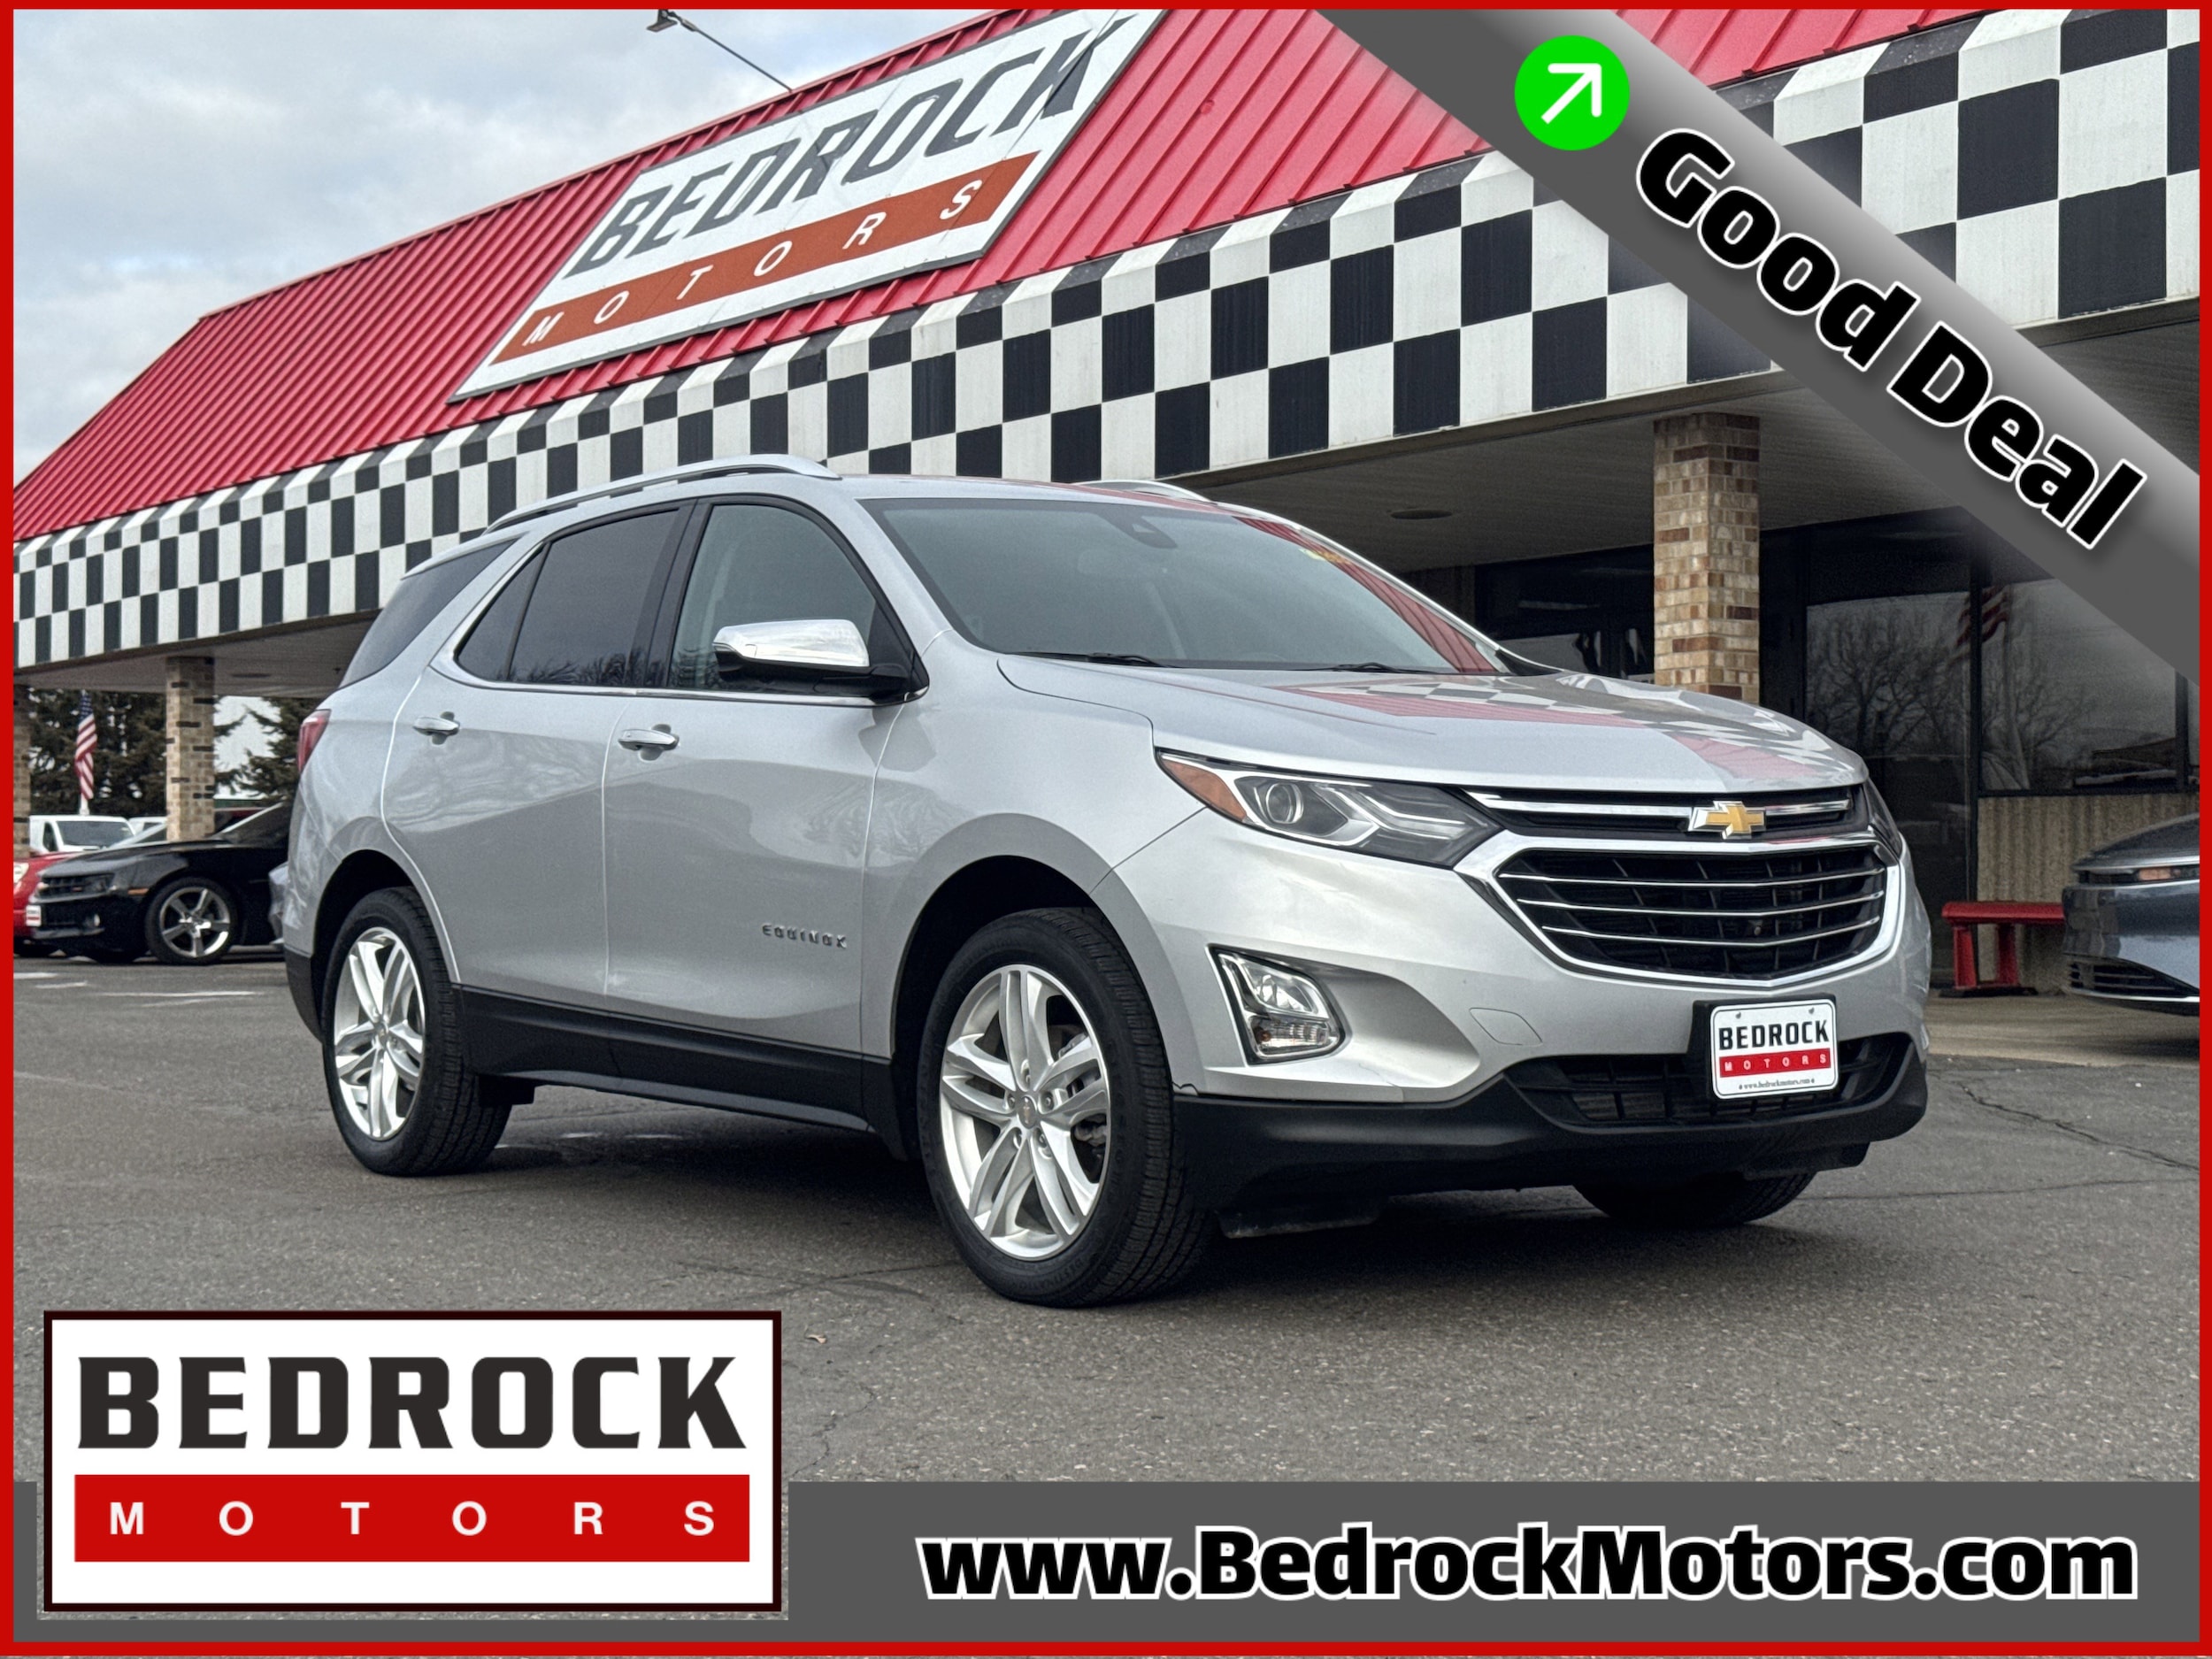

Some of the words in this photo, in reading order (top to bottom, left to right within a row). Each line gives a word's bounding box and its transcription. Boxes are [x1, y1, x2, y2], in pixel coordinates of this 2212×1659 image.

[565, 16, 1137, 279] BEDROCK
[523, 180, 982, 345] MOTORS
[762, 923, 847, 949] EQUINOX
[1718, 1019, 1829, 1050] BEDROCK
[1724, 1054, 1826, 1071] MOTORS
